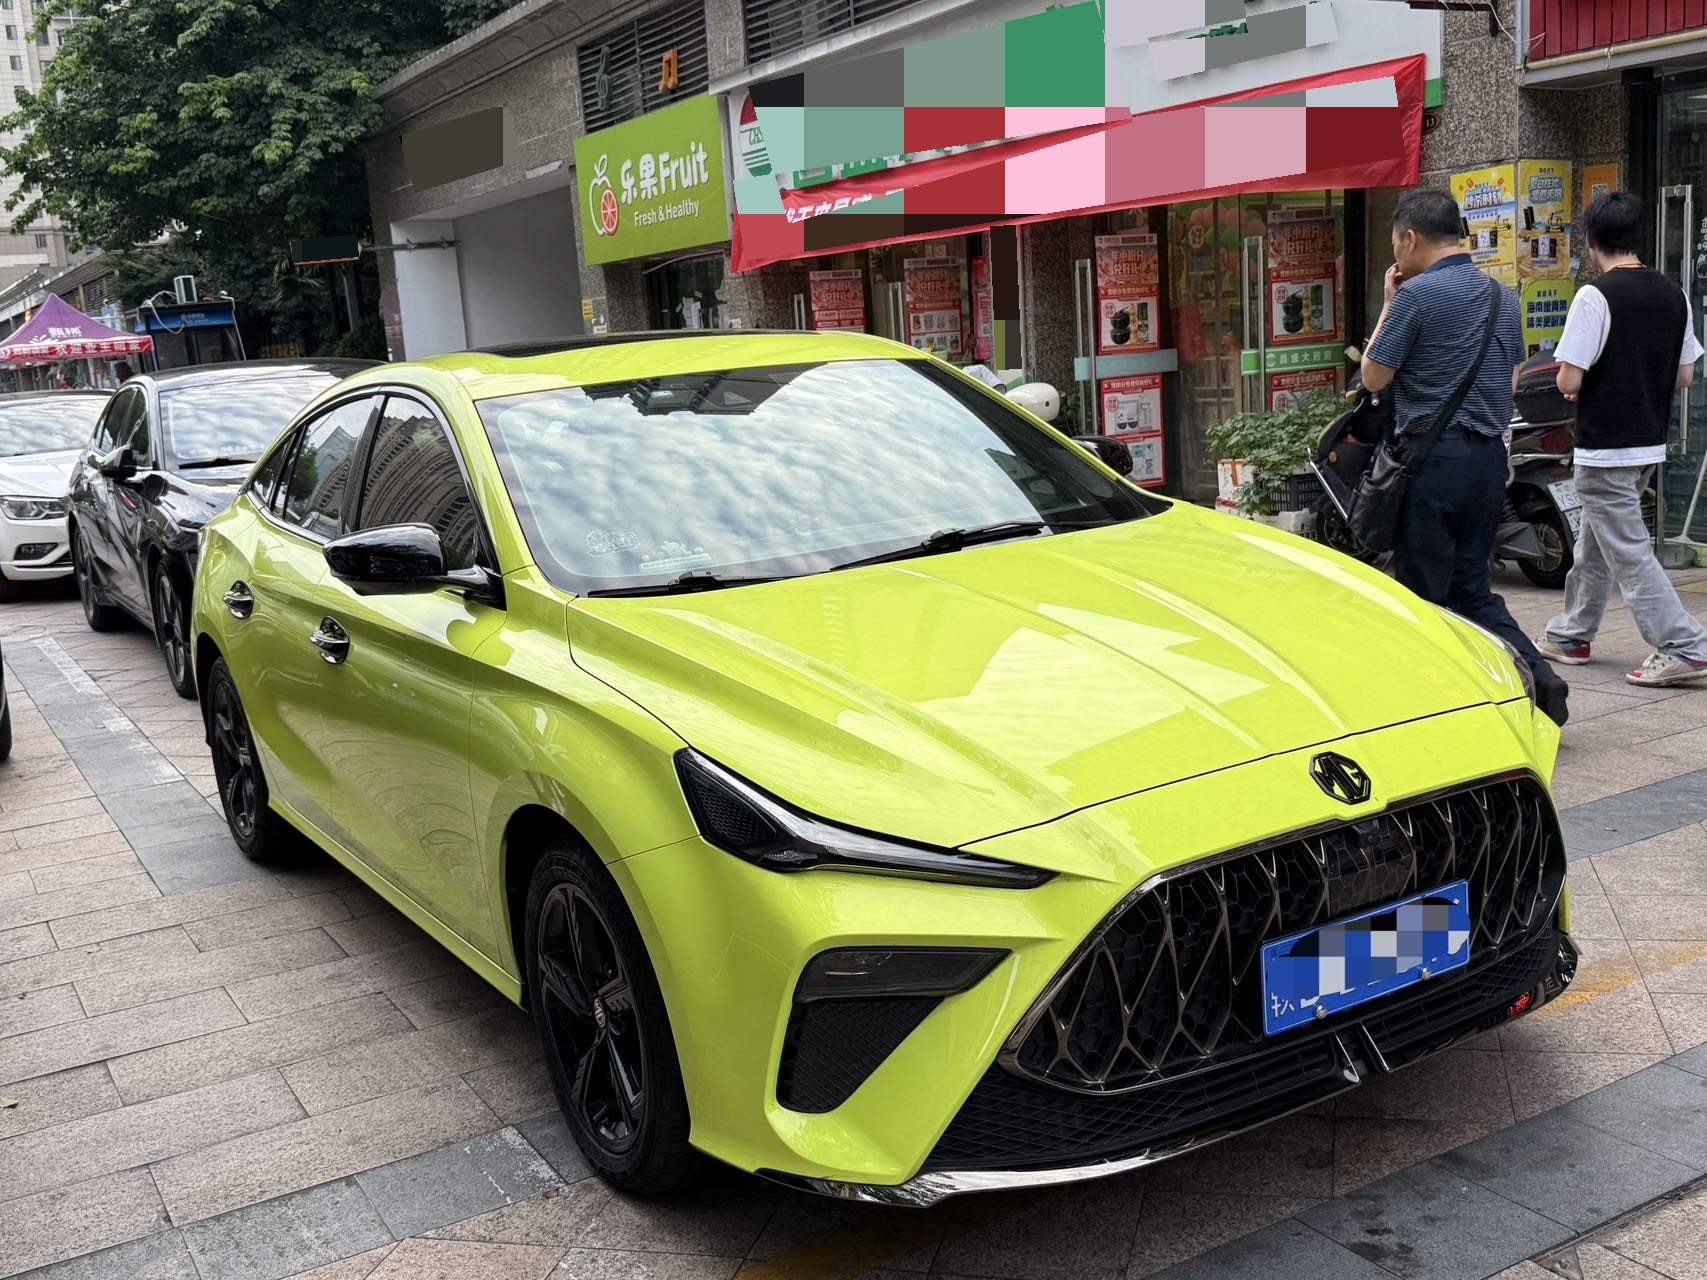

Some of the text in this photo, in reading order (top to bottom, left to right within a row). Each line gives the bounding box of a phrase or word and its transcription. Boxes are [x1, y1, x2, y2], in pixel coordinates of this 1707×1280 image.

[634, 199, 700, 227] Fresh & Healthy
[56, 341, 141, 355] 欢迎业主回家
[1310, 752, 1371, 805] MG
